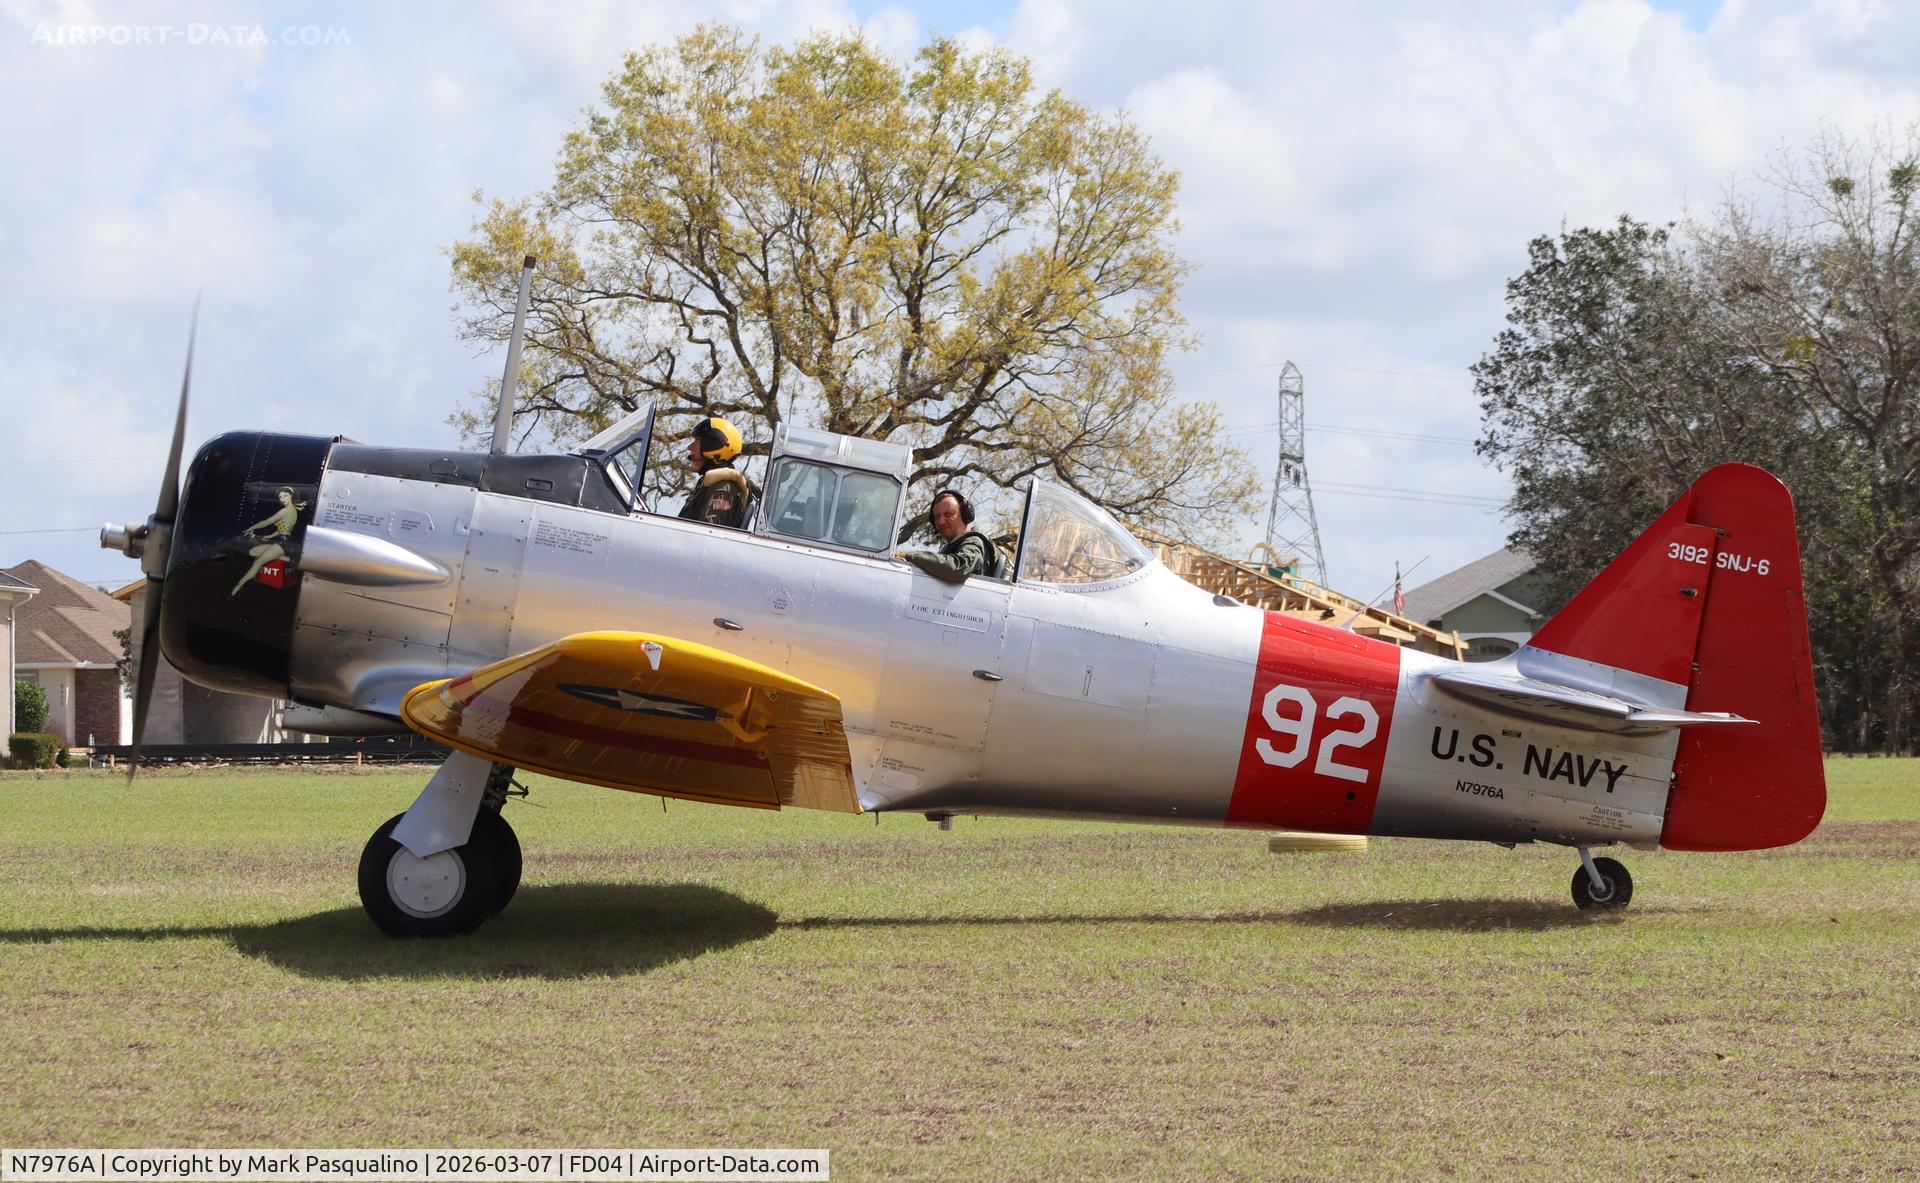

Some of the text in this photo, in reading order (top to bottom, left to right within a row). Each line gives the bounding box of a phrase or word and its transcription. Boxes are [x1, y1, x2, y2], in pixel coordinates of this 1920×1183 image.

[1667, 542, 1771, 576] 3192 SNJ-6
[932, 608, 984, 624] EXTINGUISHER
[1255, 683, 1380, 784] 92
[1431, 725, 1629, 794] U.S. NAVY
[1455, 780, 1504, 800] N7976A
